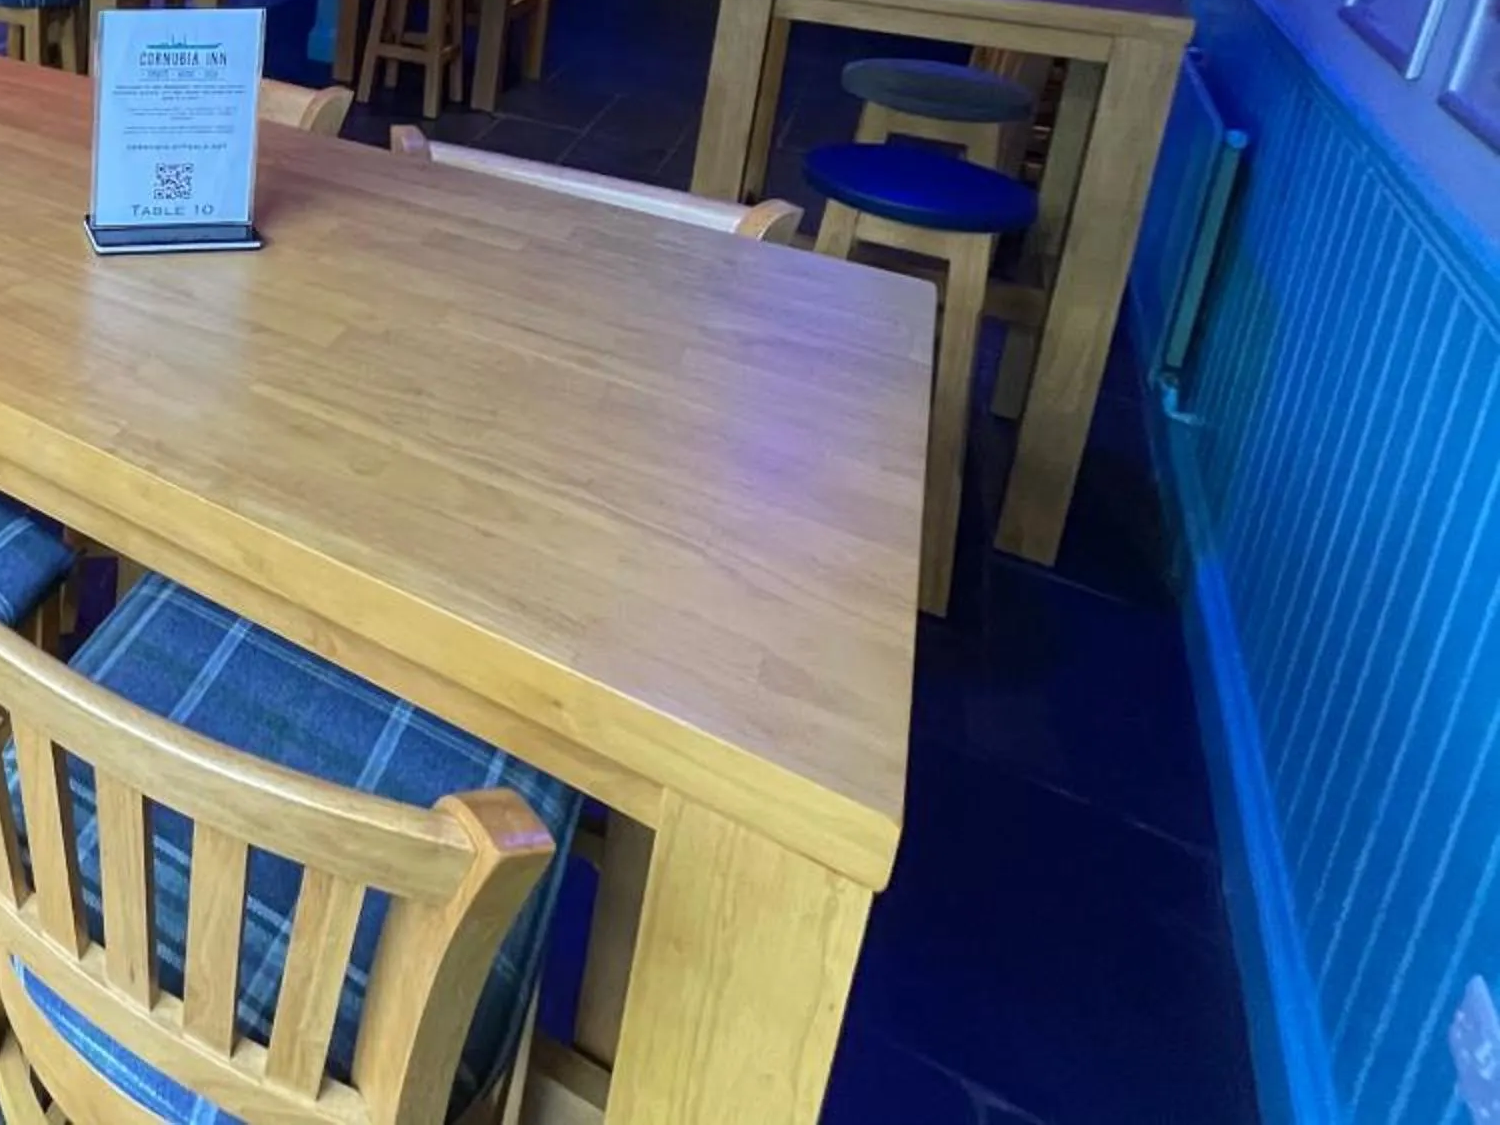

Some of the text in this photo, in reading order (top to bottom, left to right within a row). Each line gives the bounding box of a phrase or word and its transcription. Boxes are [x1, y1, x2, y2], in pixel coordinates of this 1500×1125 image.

[139, 51, 227, 66] CORNUBIA INN
[132, 204, 215, 216] TABLE 10
